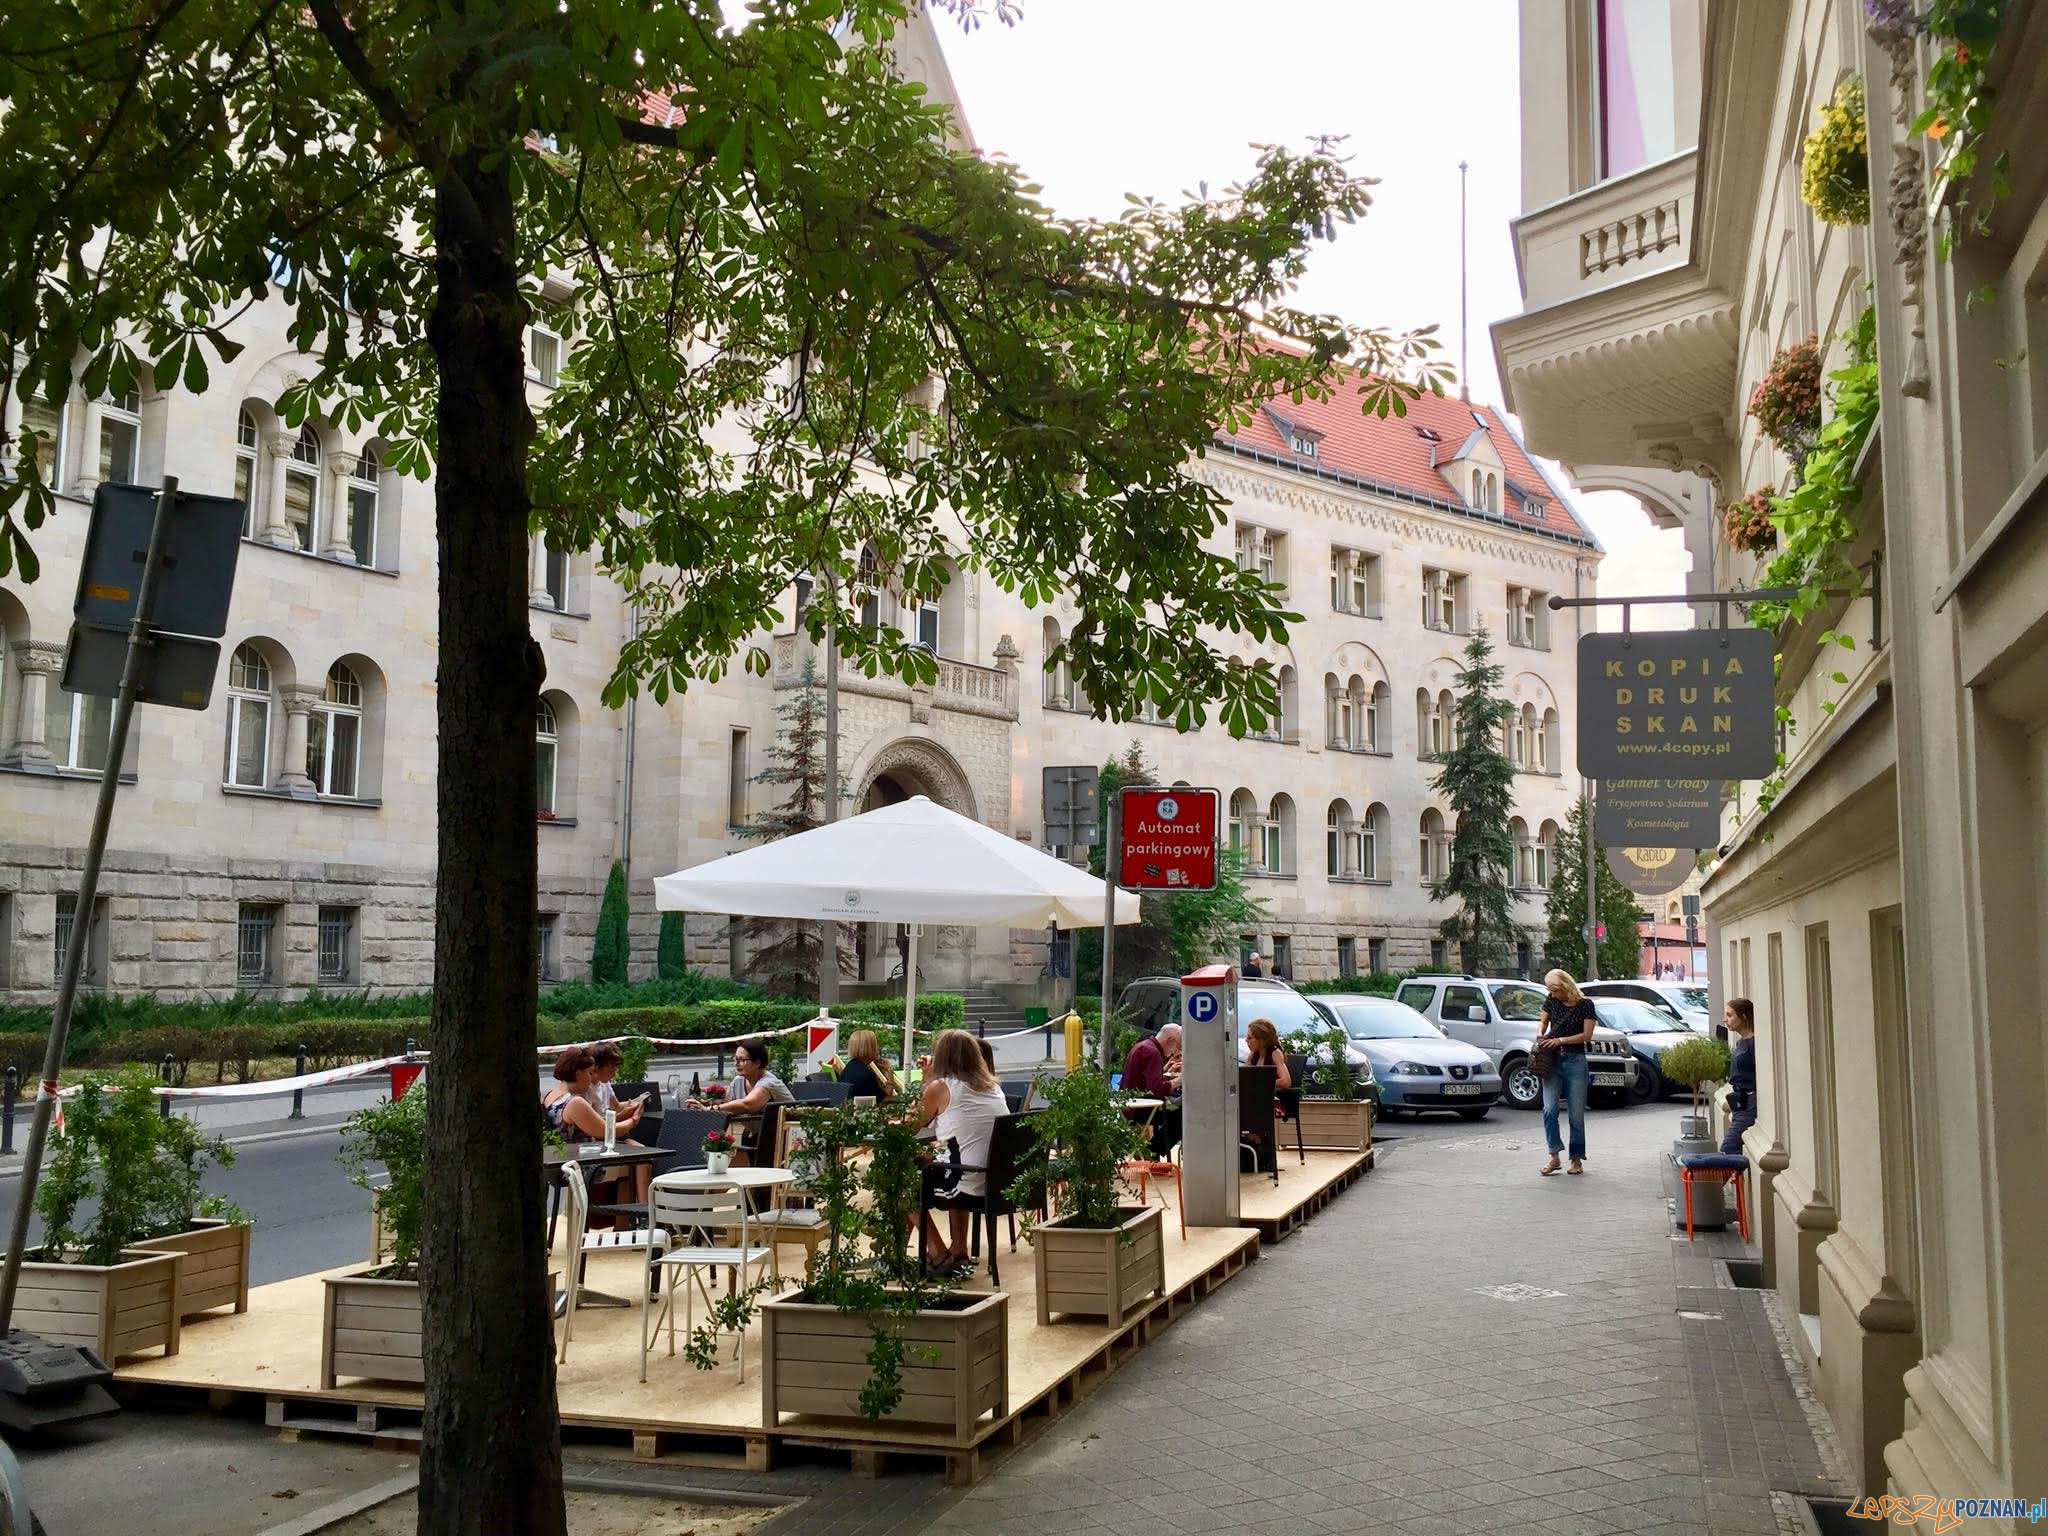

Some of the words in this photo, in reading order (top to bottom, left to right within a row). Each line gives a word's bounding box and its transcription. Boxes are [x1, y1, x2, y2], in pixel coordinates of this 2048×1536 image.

[1605, 657, 1743, 677] KOPIA
[1616, 686, 1732, 705] DRUK
[1616, 715, 1732, 734] SKAN
[1617, 742, 1731, 756] www.4copy.pl
[1608, 799, 1665, 810] Fryzjerstwo
[1667, 800, 1709, 808] Solarium
[1137, 821, 1201, 834] Automat
[1626, 817, 1689, 832] Kosmetologia
[1126, 842, 1210, 858] parkingowy
